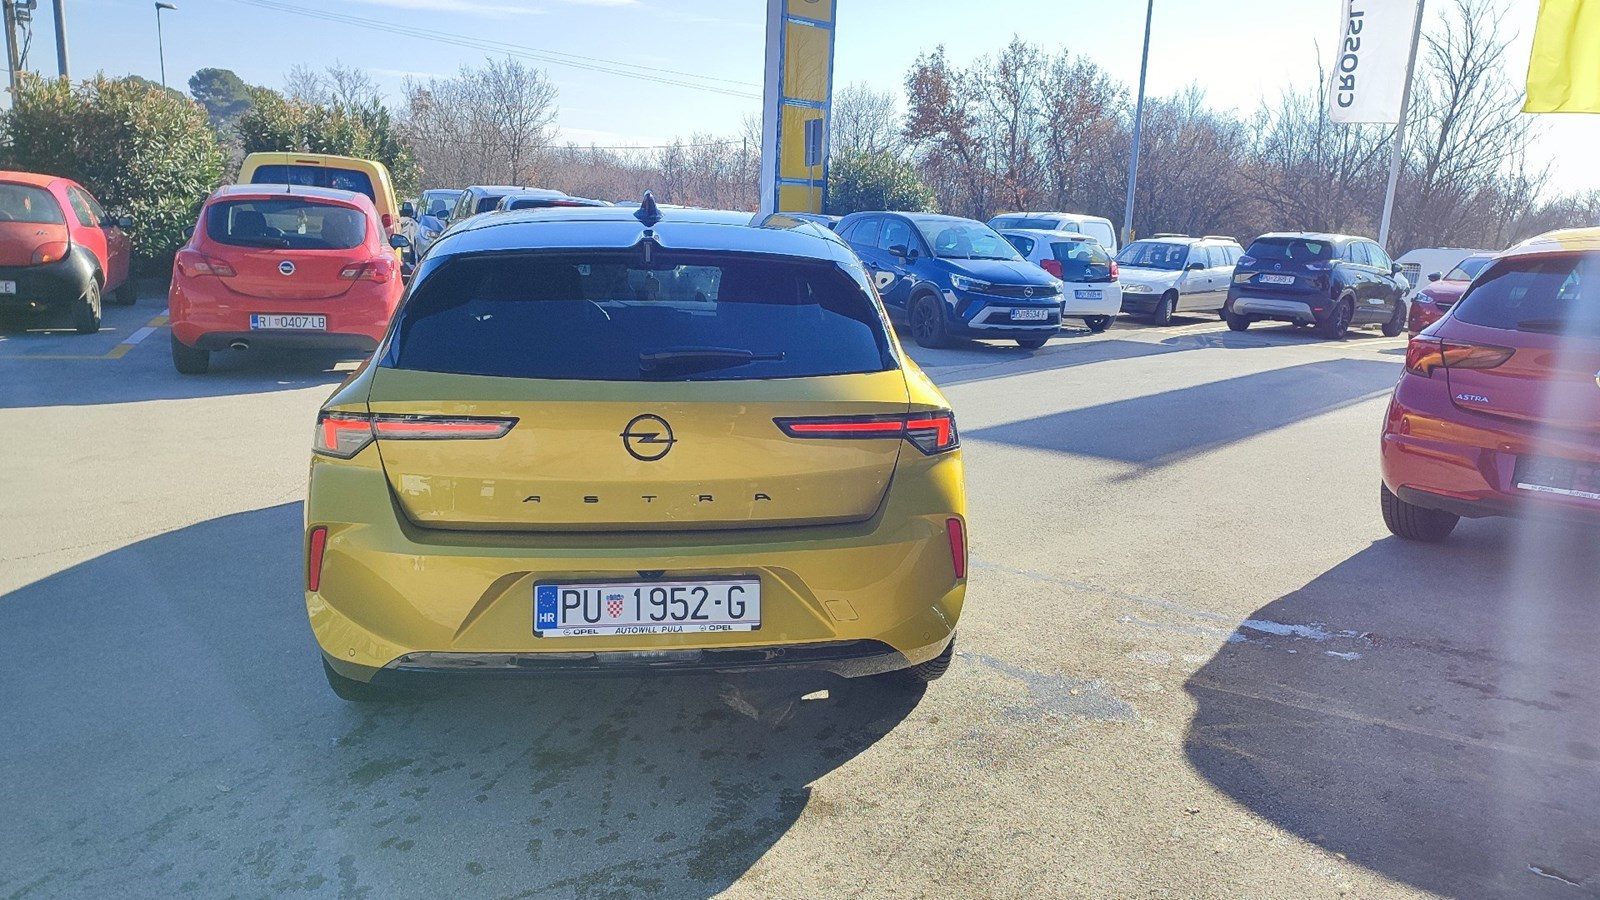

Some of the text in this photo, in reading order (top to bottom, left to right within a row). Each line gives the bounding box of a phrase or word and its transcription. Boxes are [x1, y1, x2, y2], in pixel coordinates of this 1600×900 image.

[259, 316, 271, 327] RI
[1456, 394, 1488, 402] ASTRA
[523, 493, 771, 503] ASTRA
[561, 585, 746, 623] PU 1952-G
[539, 612, 555, 623] HR
[614, 626, 657, 634] AUTOWILL
[661, 625, 684, 633] PULA
